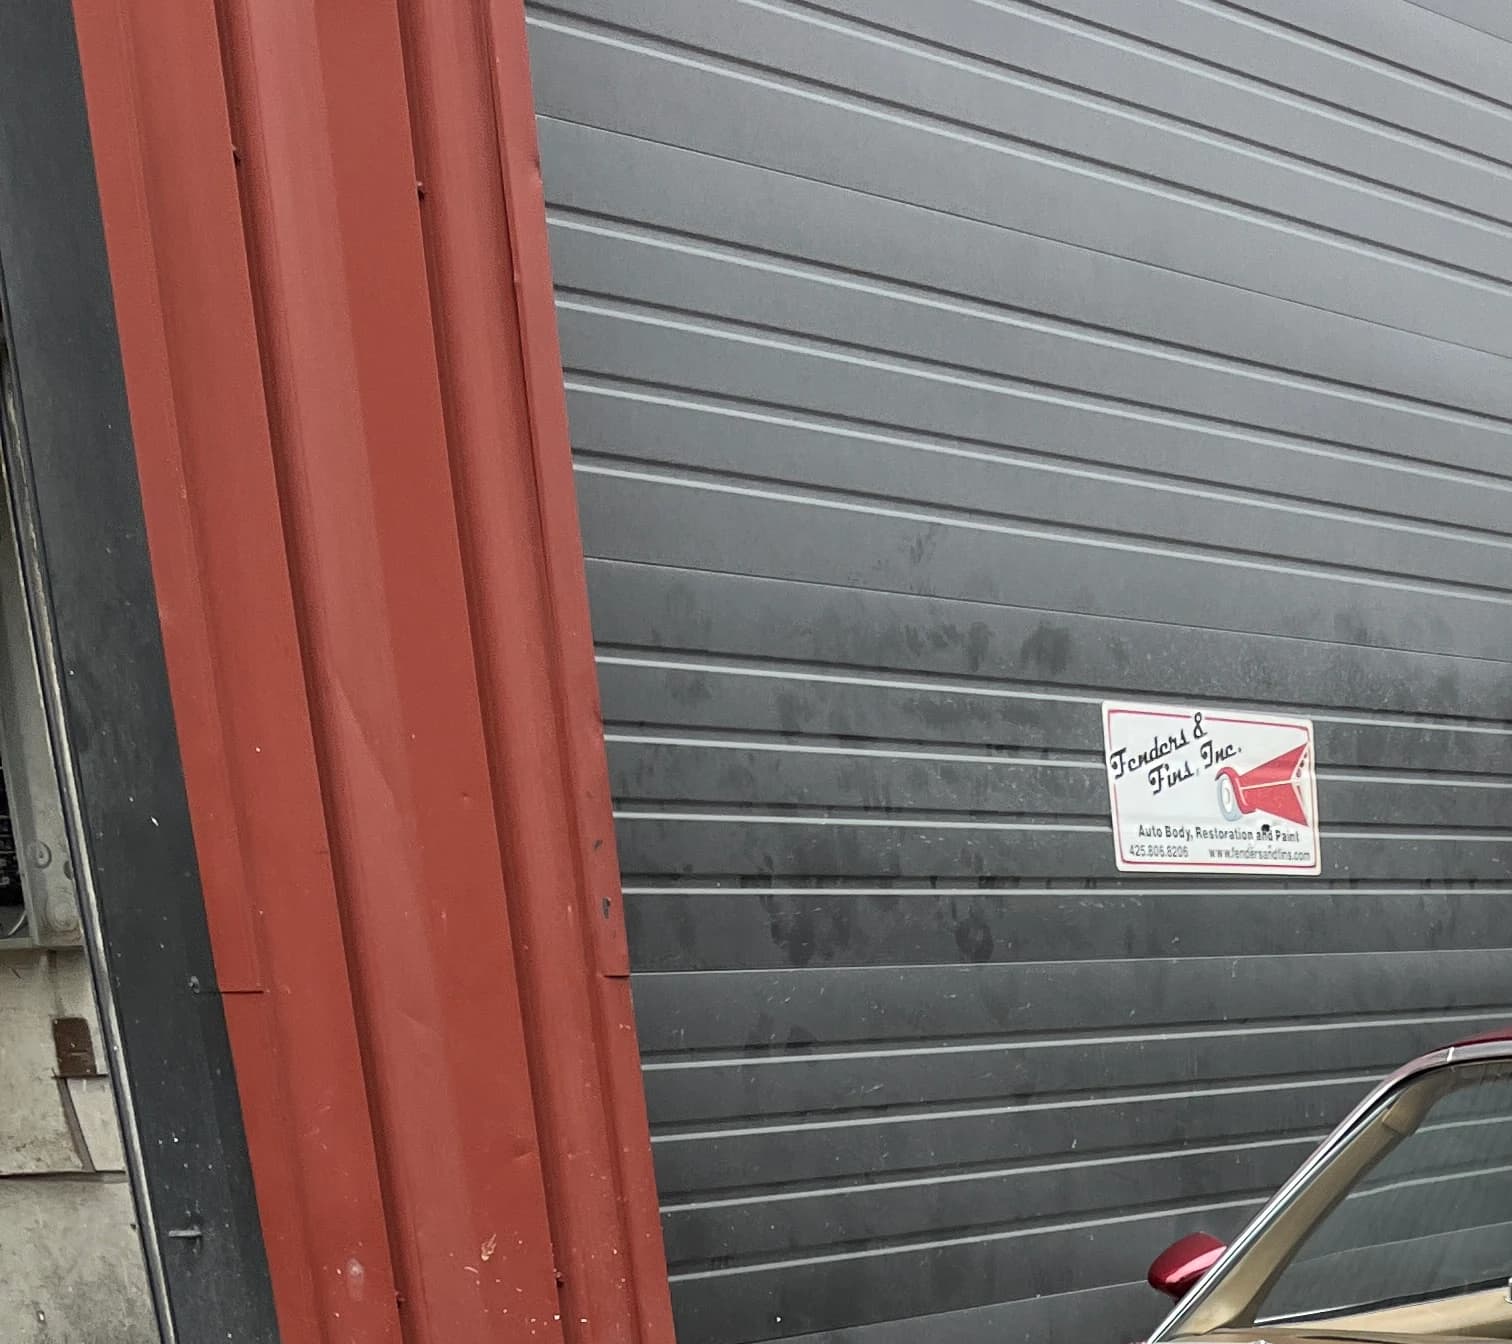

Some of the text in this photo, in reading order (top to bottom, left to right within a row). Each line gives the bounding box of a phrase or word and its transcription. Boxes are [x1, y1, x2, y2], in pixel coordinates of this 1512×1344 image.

[1110, 712, 1208, 779] Fenders &
[1201, 740, 1243, 769] Inc.
[1138, 824, 1300, 843] Auto Body, Restoration and Paint
